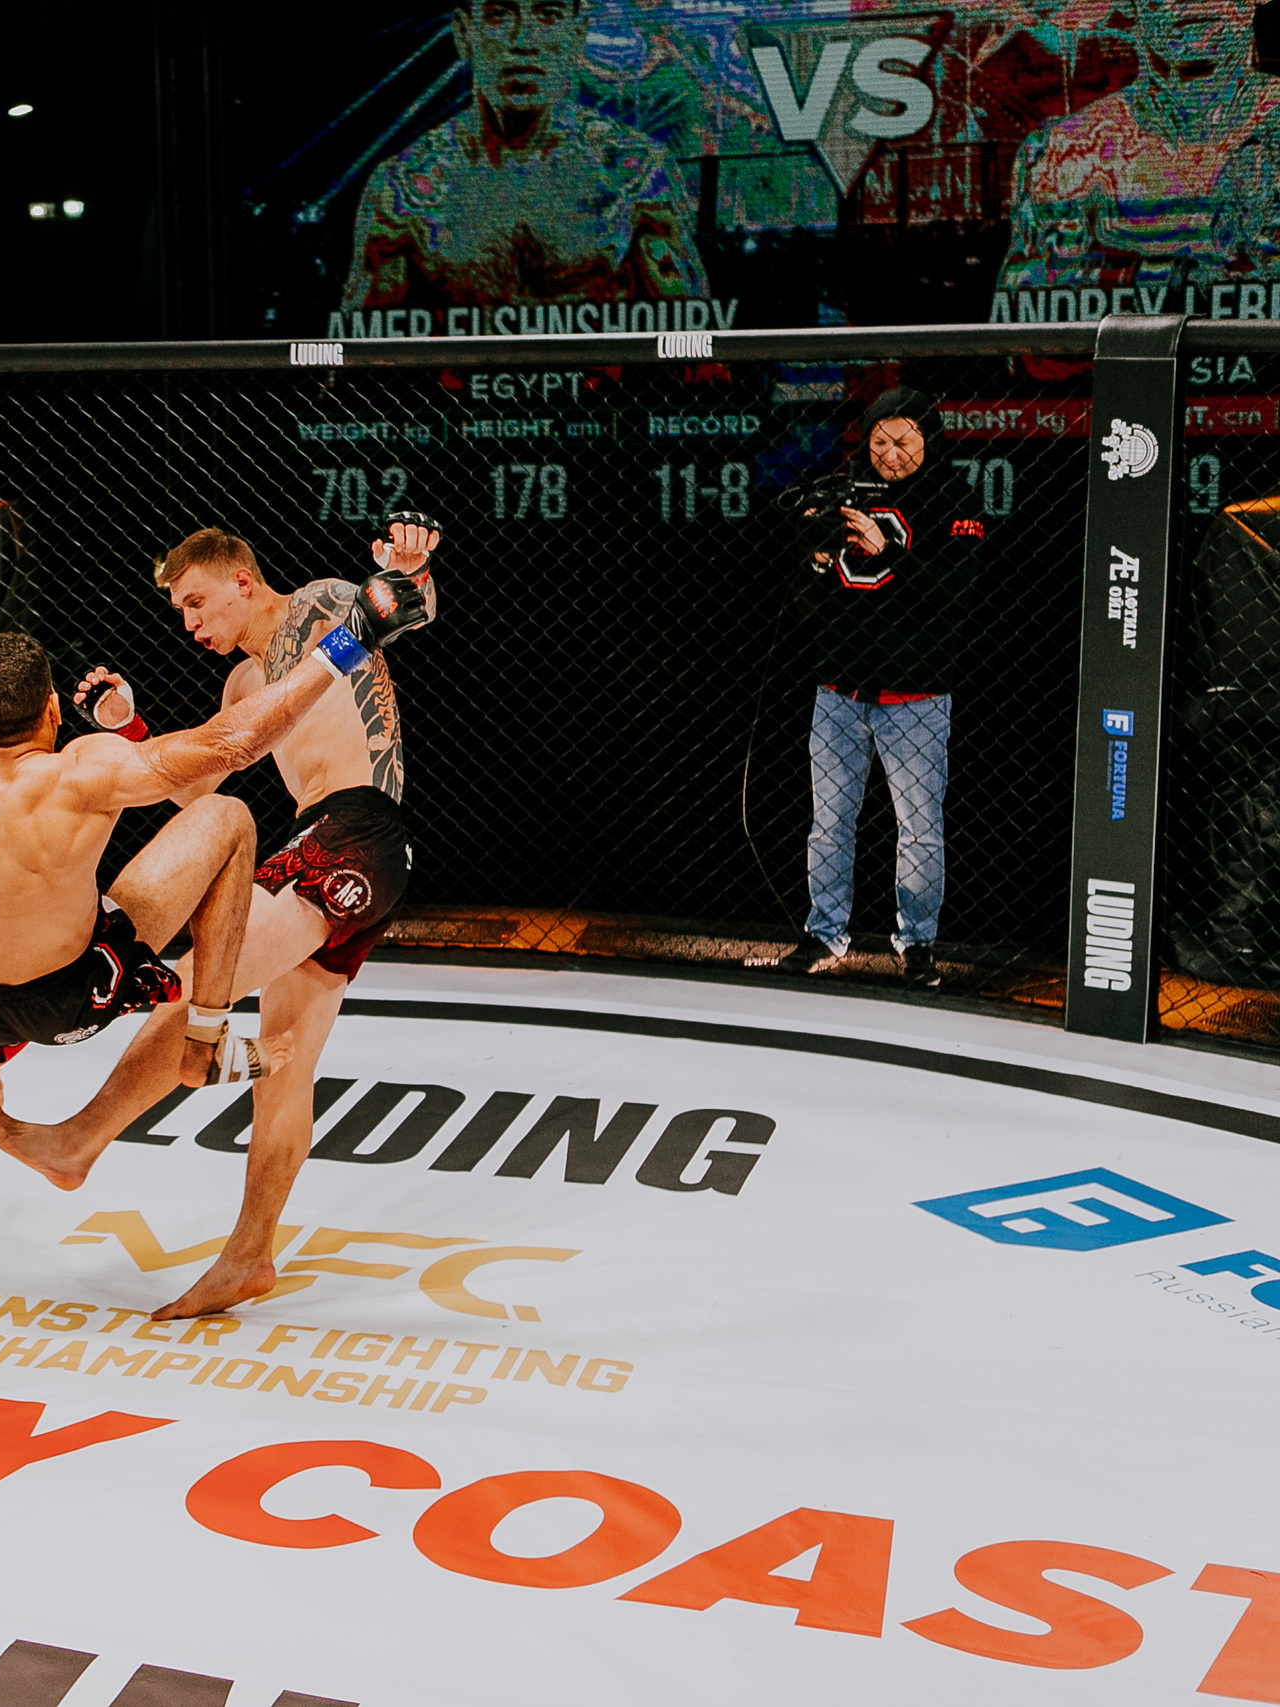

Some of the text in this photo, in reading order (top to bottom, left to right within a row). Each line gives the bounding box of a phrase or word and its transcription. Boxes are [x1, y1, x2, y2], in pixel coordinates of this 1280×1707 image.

[751, 36, 934, 142] VS
[289, 343, 344, 366] LUDING
[657, 335, 713, 358] LUDING
[1188, 355, 1257, 384] SIA
[471, 371, 584, 399] EGYPT
[649, 415, 760, 438] RECORD
[939, 409, 1065, 434] EIGHT, kg
[490, 464, 568, 519] 178
[654, 462, 750, 521] 11-8
[1111, 740, 1128, 821] FORTUNA
[1084, 878, 1135, 992] LUDING
[111, 1076, 777, 1196] LUDING
[59, 1210, 584, 1323] MFC
[256, 1323, 635, 1393] FIGHTING
